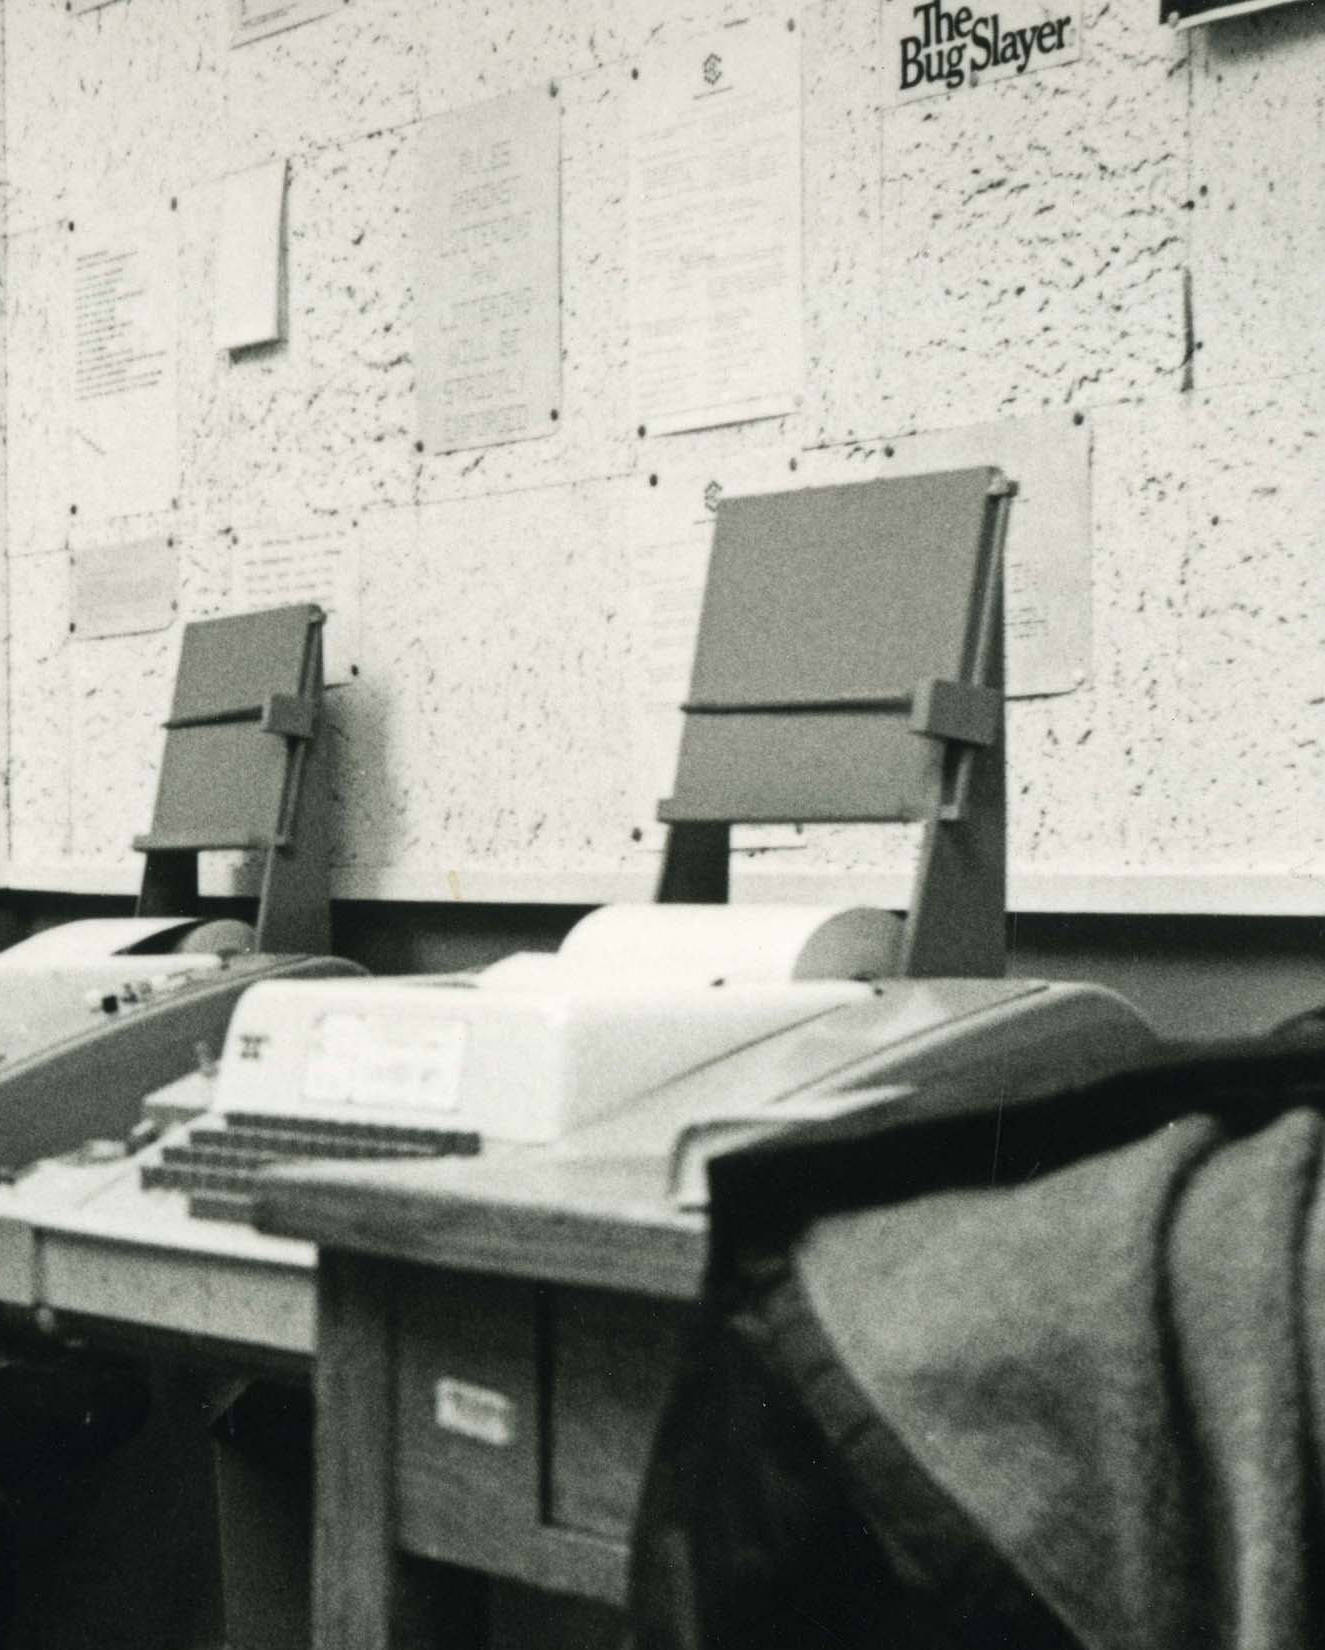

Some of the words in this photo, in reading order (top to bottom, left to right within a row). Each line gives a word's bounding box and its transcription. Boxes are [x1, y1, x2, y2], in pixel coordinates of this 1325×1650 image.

[899, 36, 967, 90] Bug
[970, 13, 1071, 74] Slayer
[914, 0, 973, 48] The
